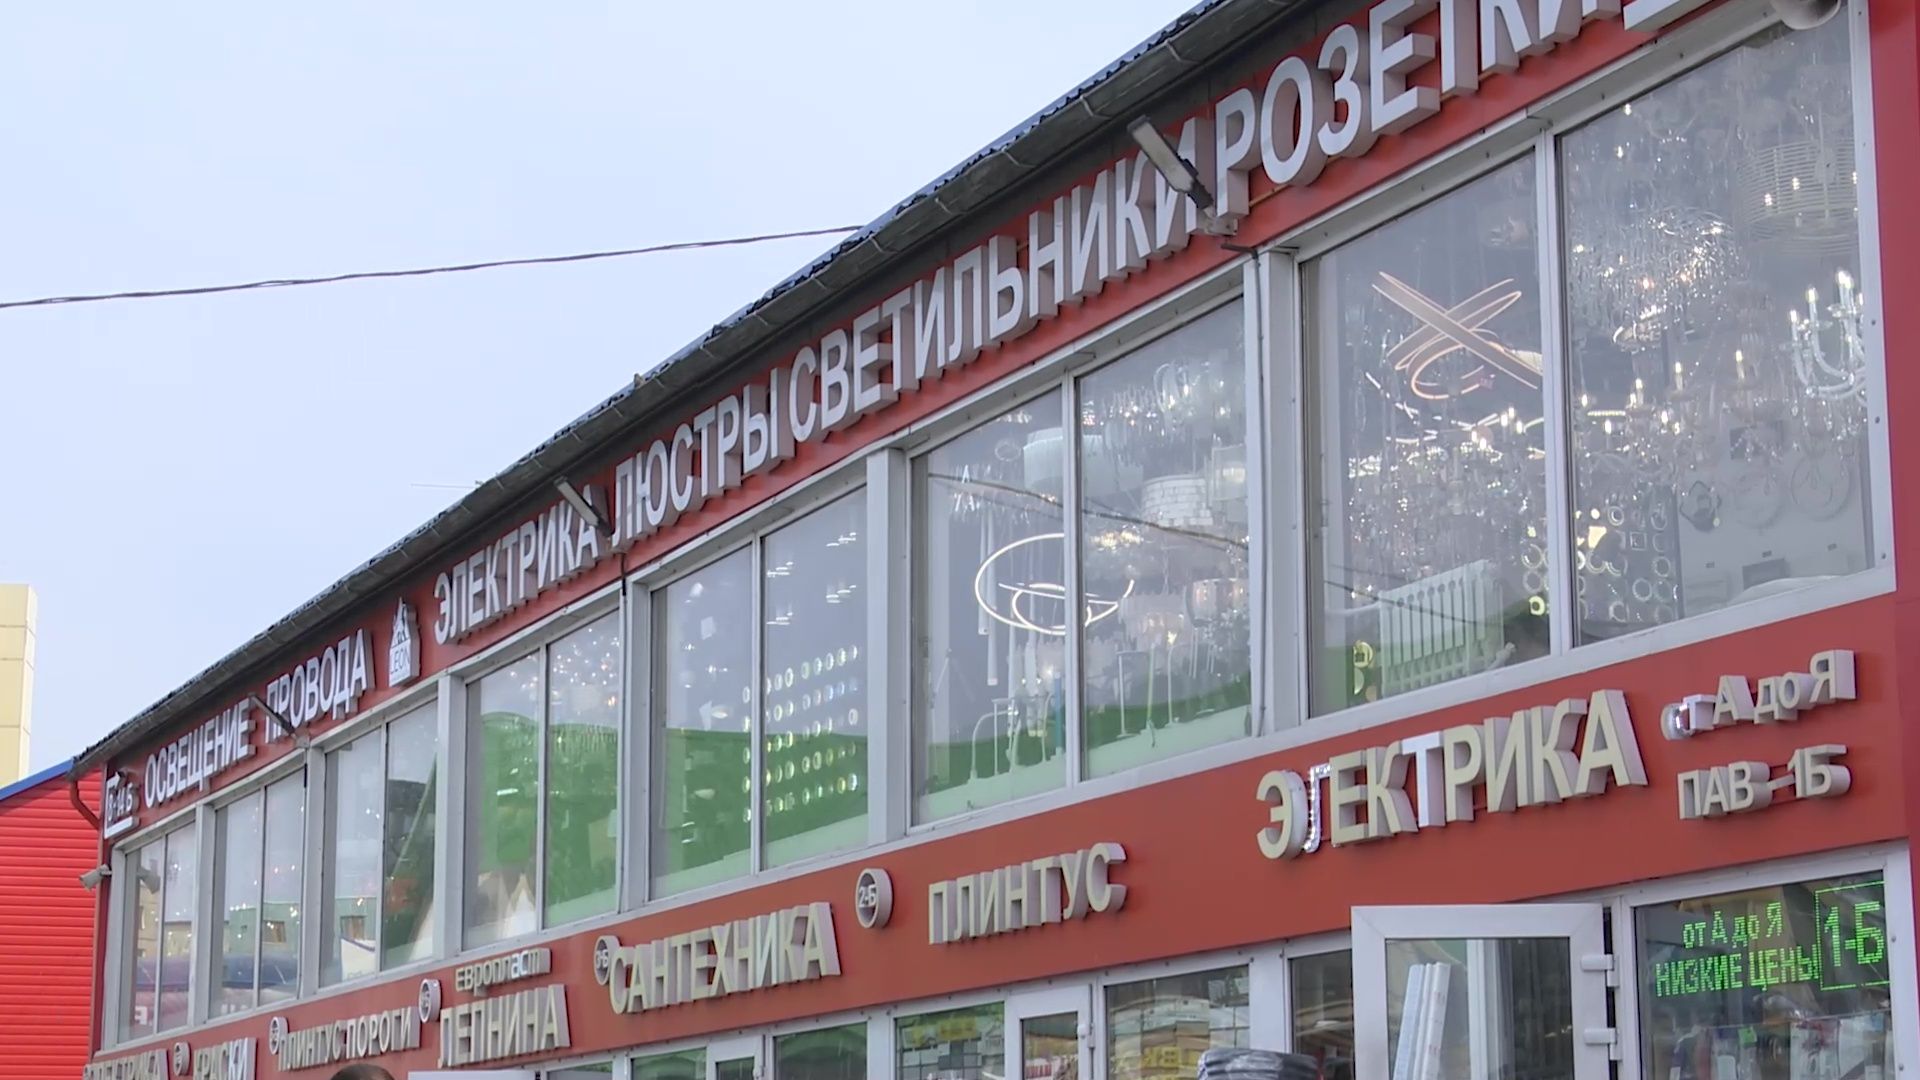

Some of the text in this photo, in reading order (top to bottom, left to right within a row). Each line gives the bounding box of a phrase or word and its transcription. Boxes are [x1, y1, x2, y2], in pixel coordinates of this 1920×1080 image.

[1215, 0, 1600, 219] РОЗЕТК
[789, 117, 1197, 442] СВЕТИЛЬНИКИ
[612, 368, 780, 548] ЛЮСТРЫ
[434, 484, 599, 645] ЭЛЕКТРИКА
[145, 628, 370, 808] ОСВЕЩЕНИЕ ПРОВОДА
[1713, 675, 1746, 725] А
[1754, 672, 1803, 724] до
[1810, 650, 1844, 704] Я
[1257, 690, 1635, 859] ЭЛЕКТРИКА
[929, 843, 1120, 945] ПЛИНТУС
[1682, 902, 1782, 948] от А до Я
[1824, 900, 1885, 967] 1-Б
[609, 902, 836, 1014] САНТЕХНИКА
[1655, 944, 1819, 997] НИЗКИЕ ЦЕНЫ
[346, 1006, 413, 1059] ПОРОГИ
[438, 984, 564, 1068] ЛЕПНИНА
